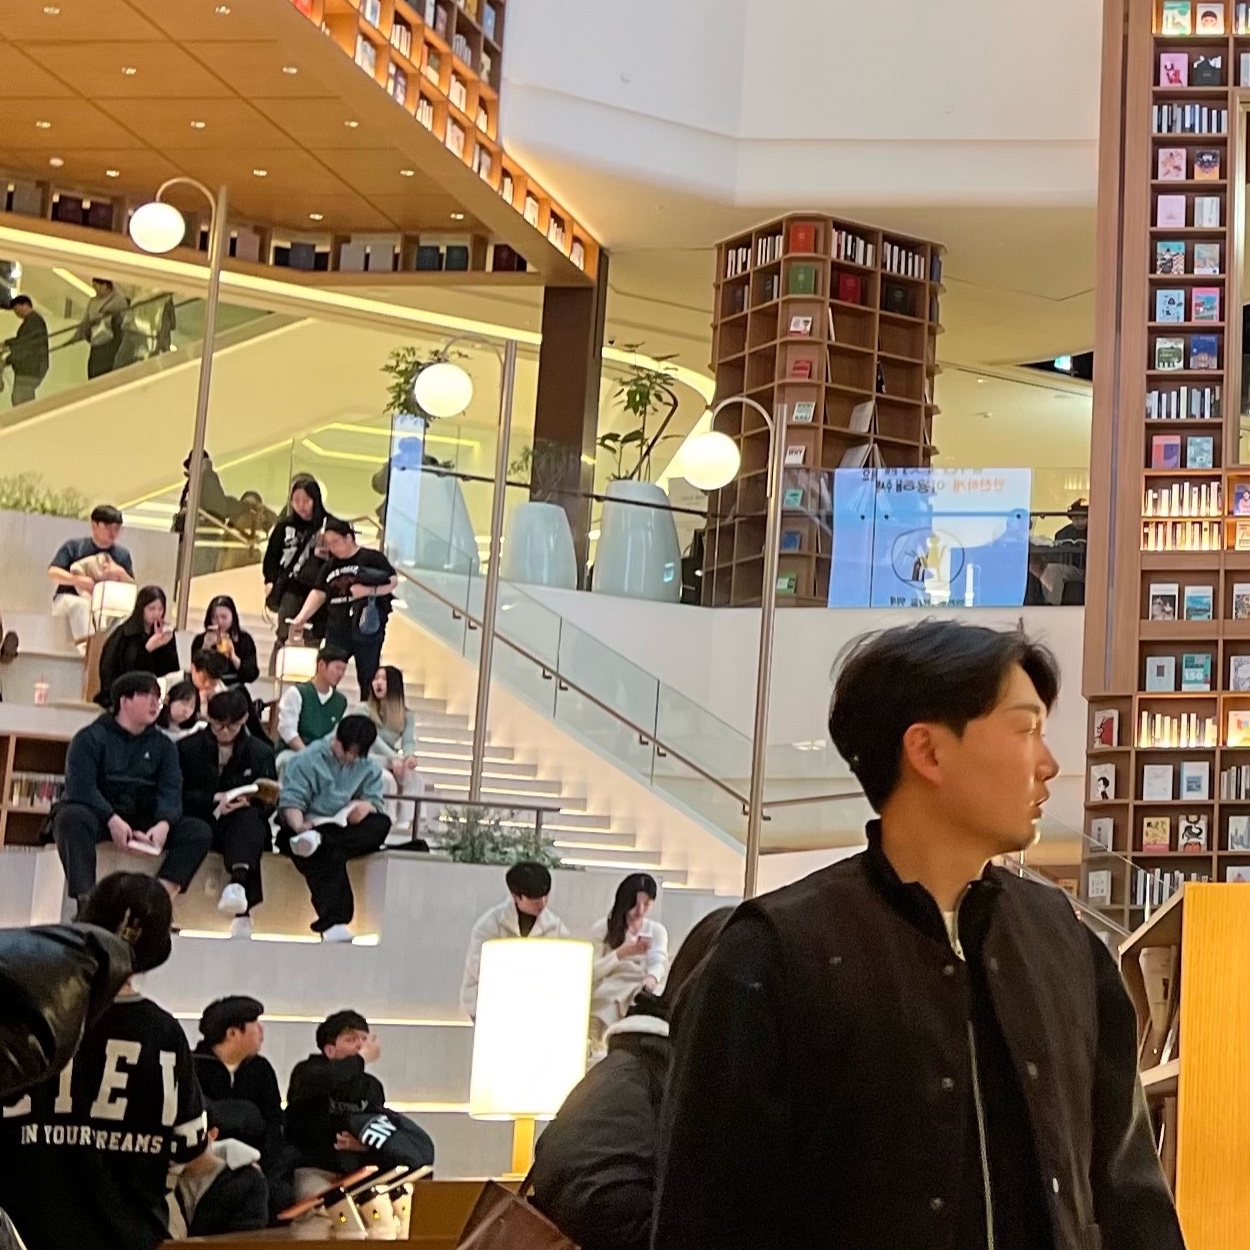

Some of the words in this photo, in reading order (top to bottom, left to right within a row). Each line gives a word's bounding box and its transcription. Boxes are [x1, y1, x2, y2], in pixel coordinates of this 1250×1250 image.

[21, 1123, 38, 1145] IN
[44, 1124, 92, 1146] YOUR
[92, 1129, 164, 1154] REAMS
